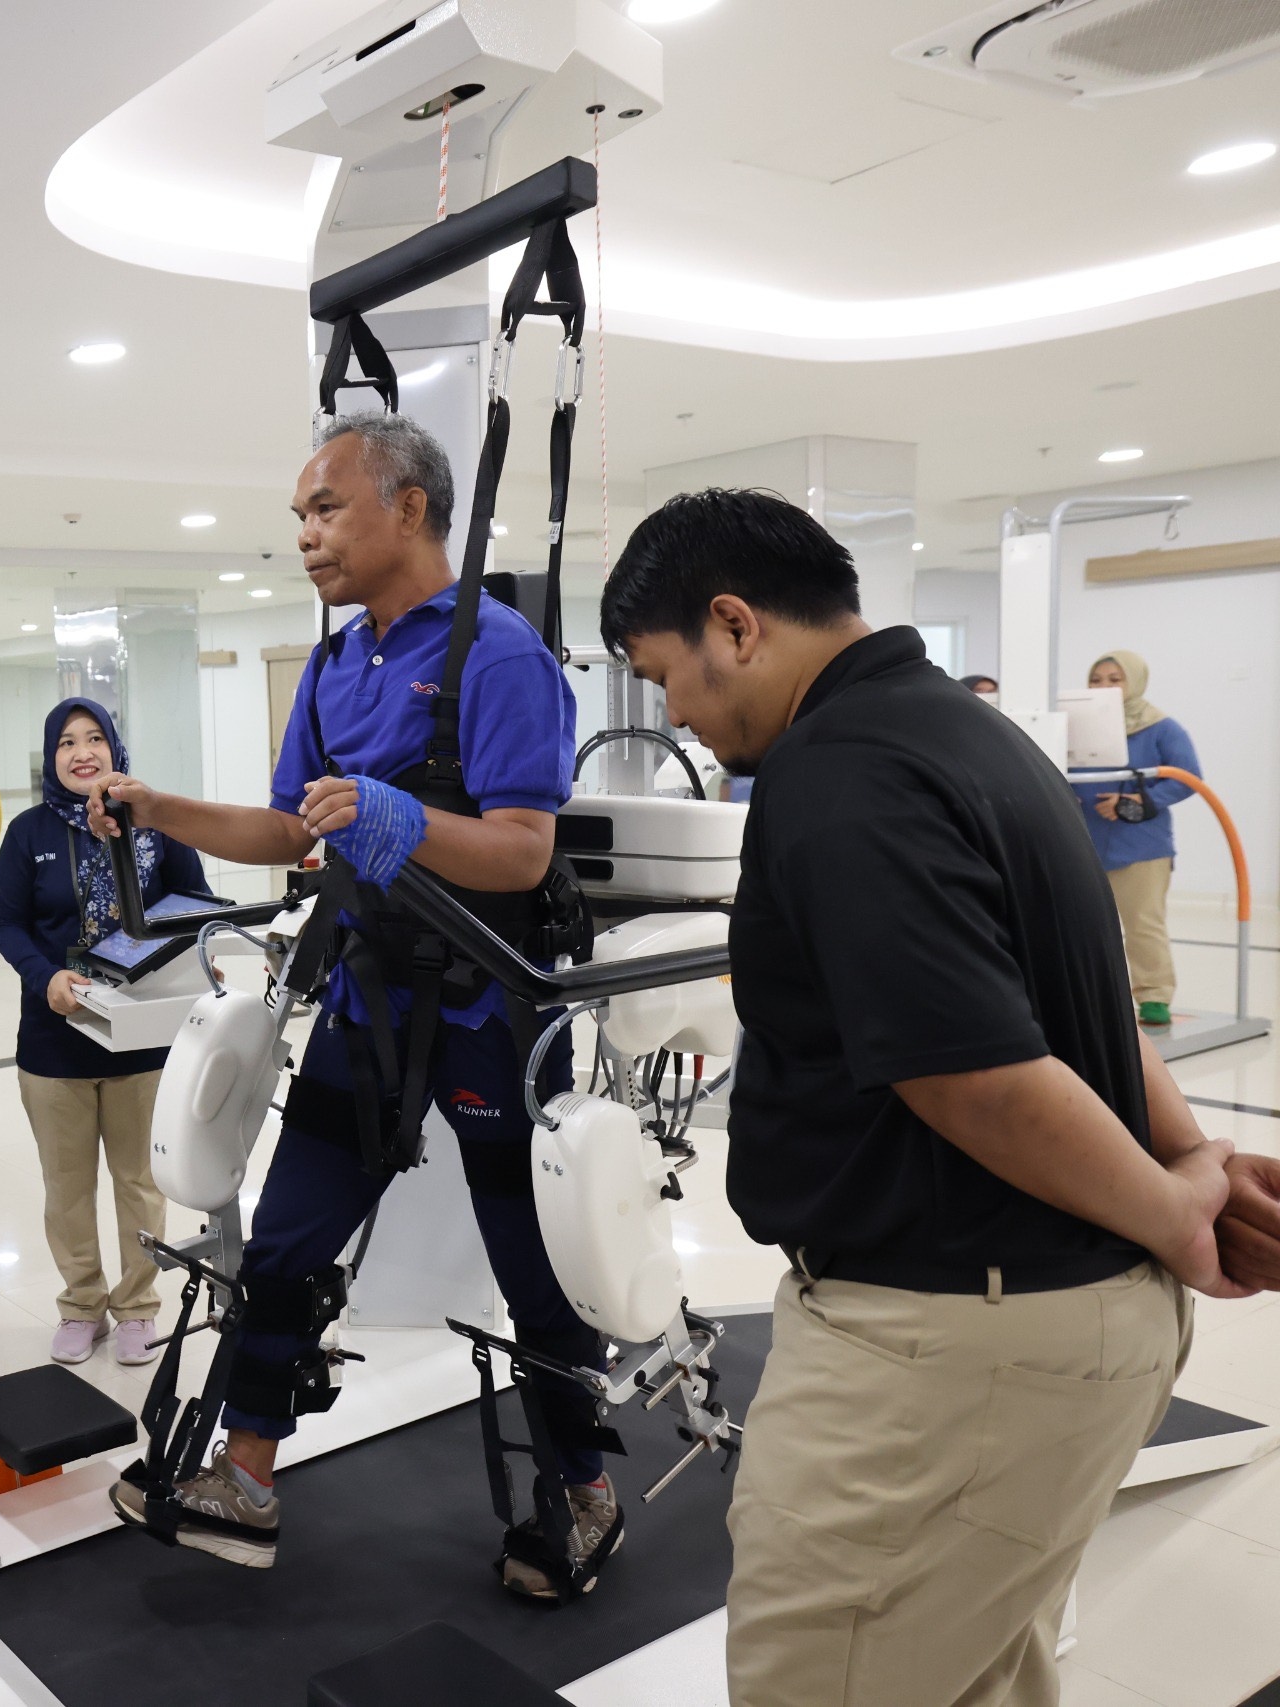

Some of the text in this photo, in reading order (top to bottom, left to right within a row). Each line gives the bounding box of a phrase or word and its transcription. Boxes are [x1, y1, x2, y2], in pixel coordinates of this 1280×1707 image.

[457, 1104, 500, 1117] RUNNER
[200, 1501, 225, 1518] N
[585, 1525, 604, 1548] N
